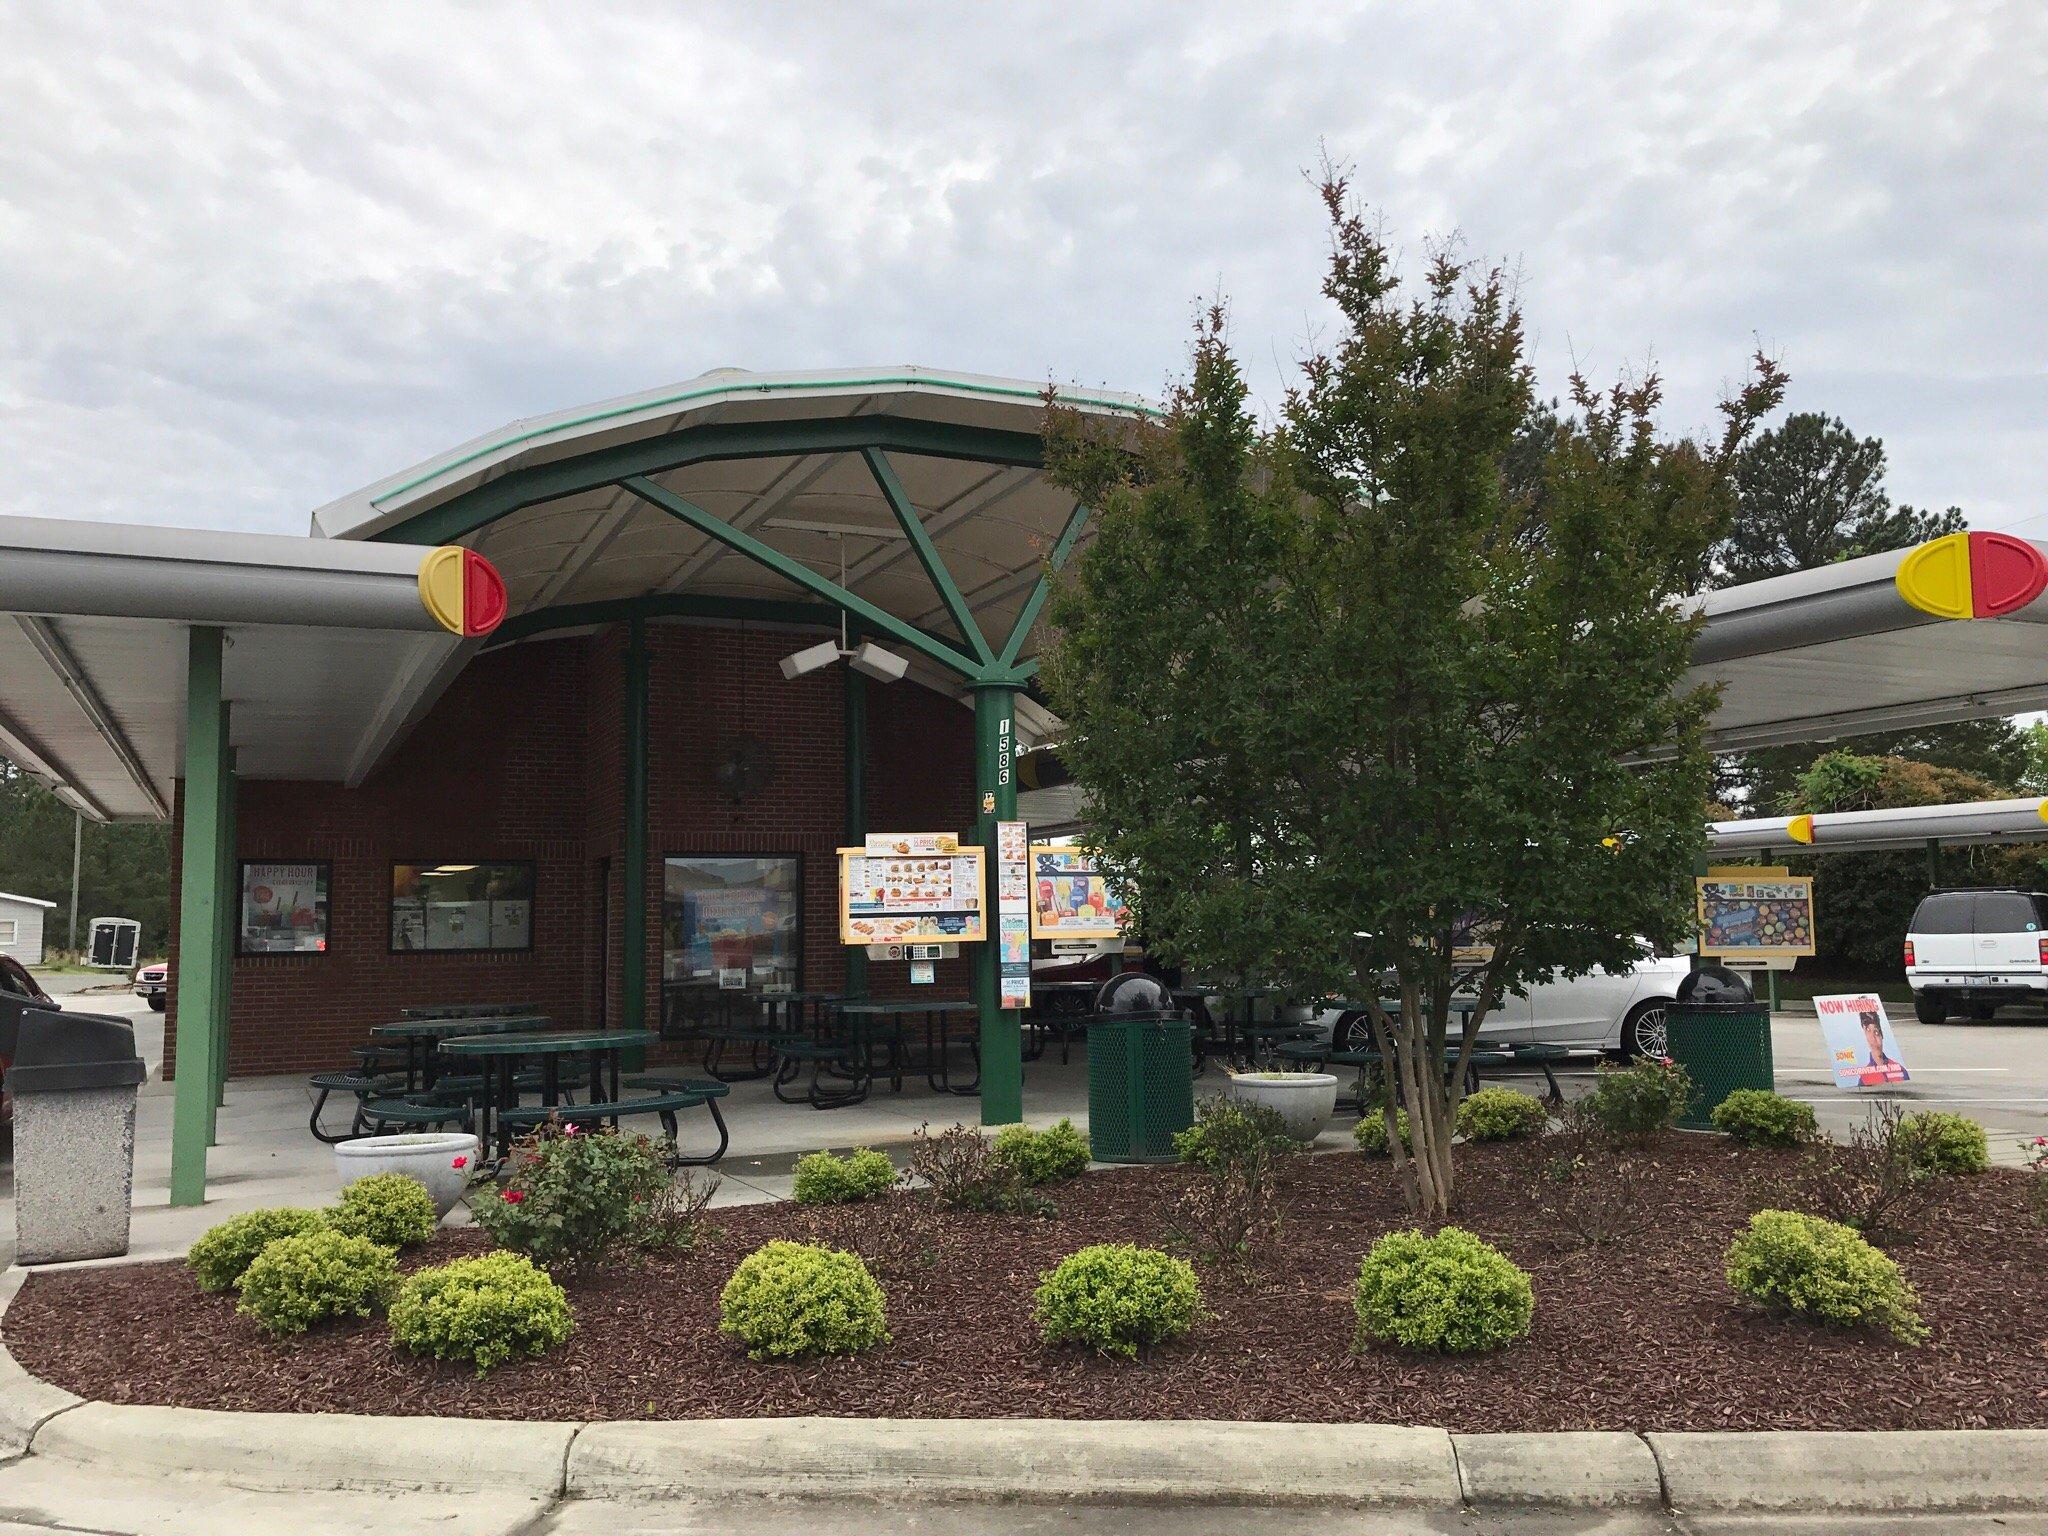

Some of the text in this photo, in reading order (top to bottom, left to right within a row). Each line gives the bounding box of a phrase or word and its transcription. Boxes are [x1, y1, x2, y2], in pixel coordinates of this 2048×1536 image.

[1000, 720, 1009, 784] 1586
[253, 867, 314, 877] HAPPY HOUR
[1819, 998, 1879, 1014] NOW HIRING
[1835, 1051, 1855, 1061] SONIC
